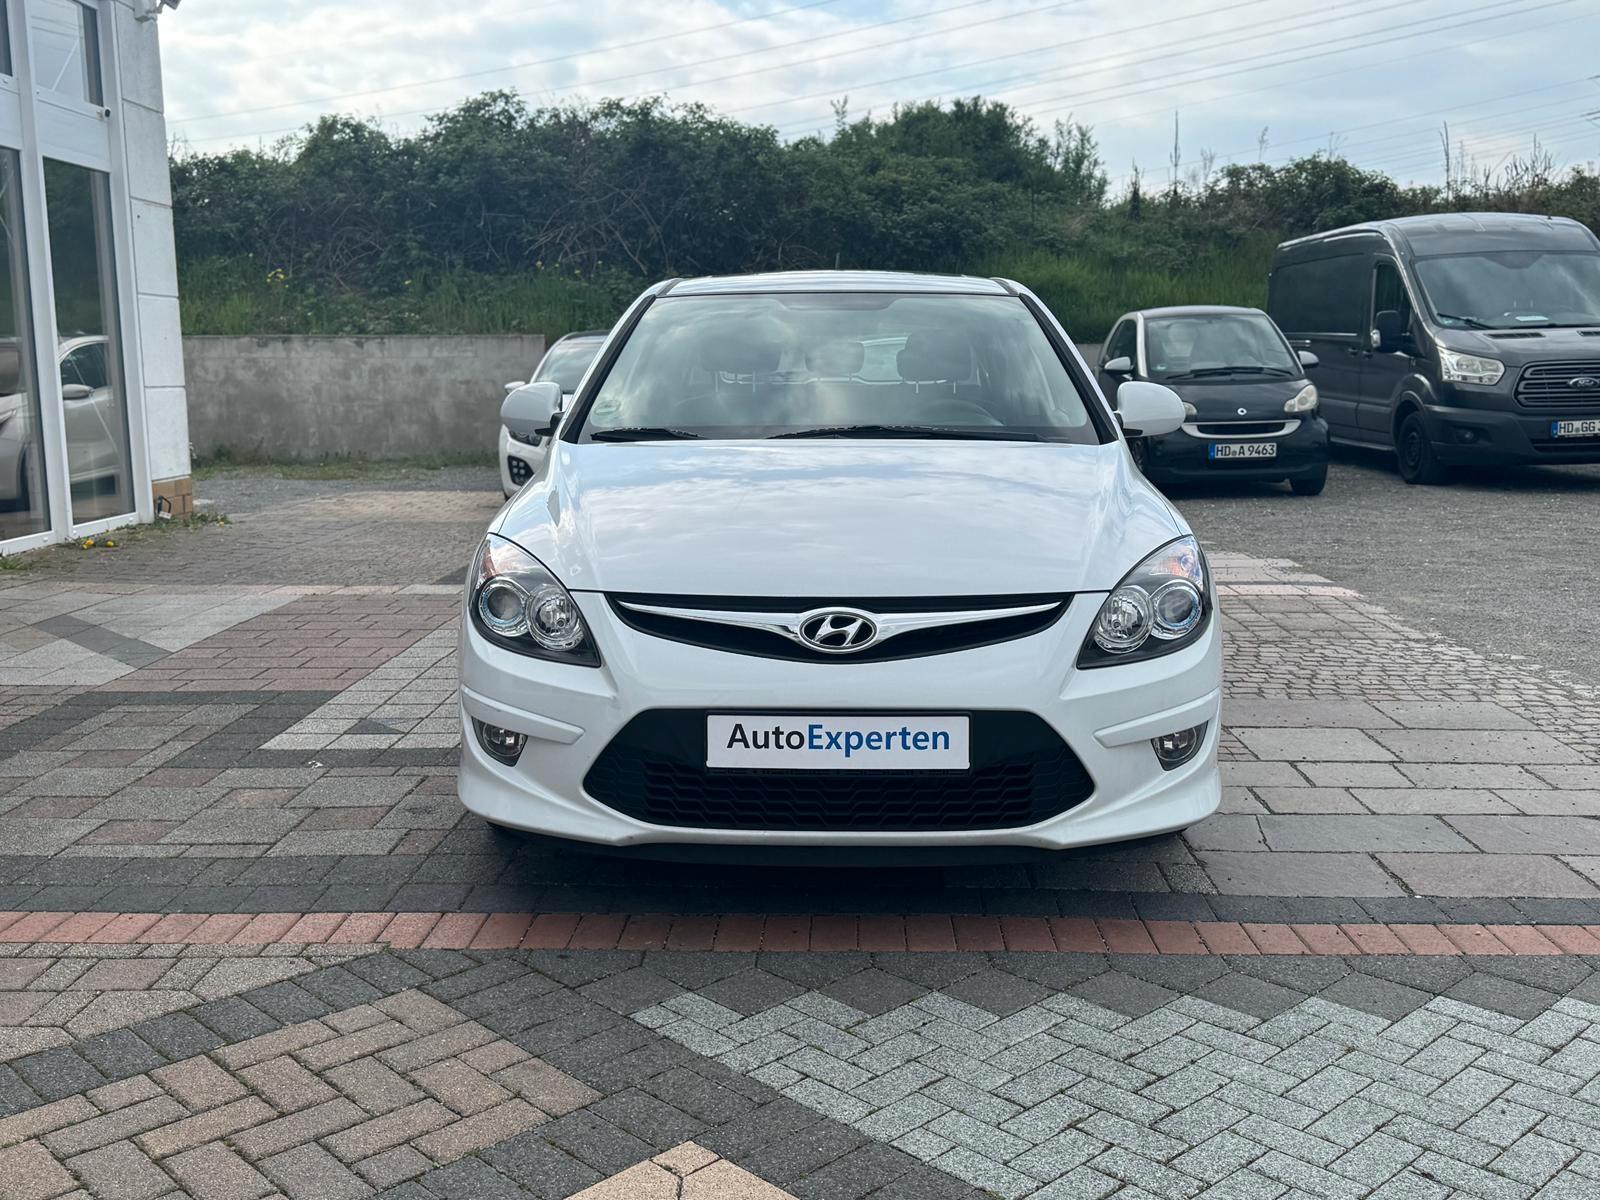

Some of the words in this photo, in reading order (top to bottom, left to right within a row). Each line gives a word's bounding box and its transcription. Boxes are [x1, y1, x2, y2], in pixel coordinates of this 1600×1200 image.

[1559, 422, 1574, 434] HD
[1581, 421, 1596, 433] GG
[1216, 446, 1231, 456] HD
[1238, 445, 1245, 456] A
[1247, 444, 1275, 456] 9463
[726, 723, 950, 758] AutoExperten
